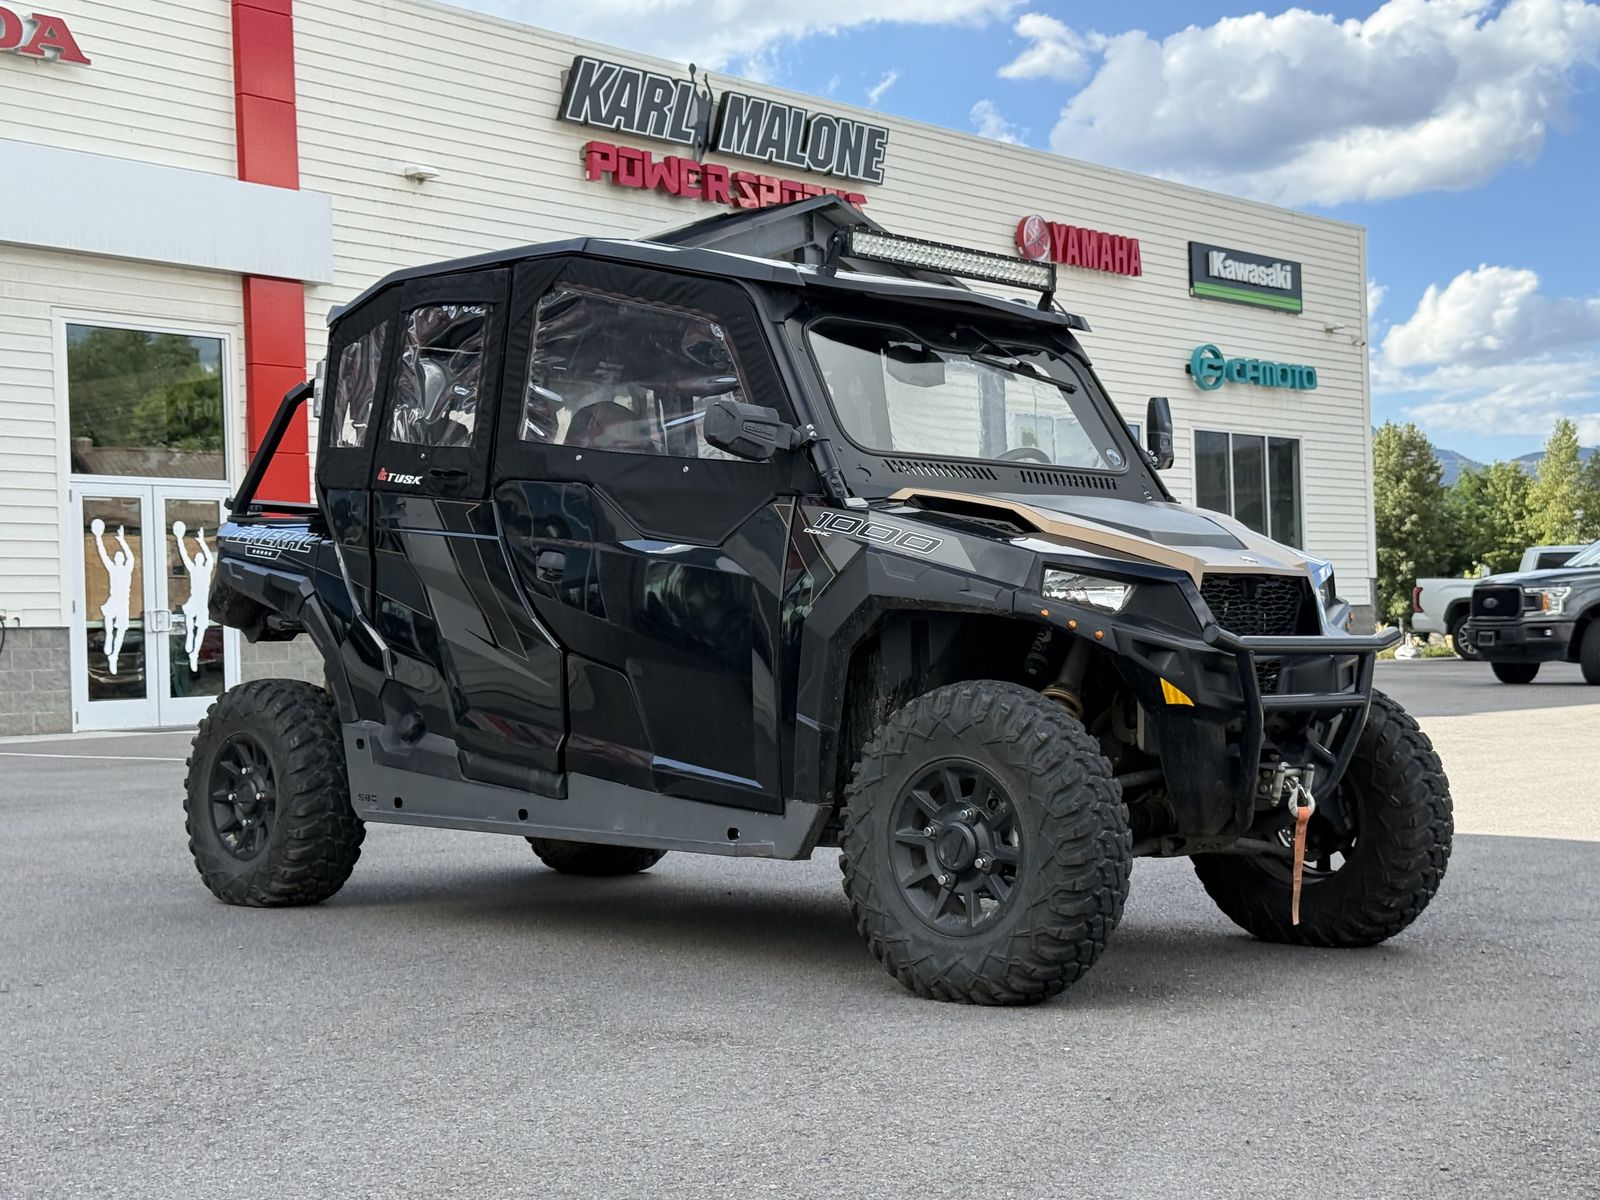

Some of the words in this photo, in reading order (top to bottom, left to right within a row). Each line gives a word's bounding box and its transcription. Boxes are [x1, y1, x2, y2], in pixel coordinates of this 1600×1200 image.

[562, 57, 697, 145] KARL
[714, 92, 889, 185] MALONE
[1047, 222, 1142, 276] YAMAHA
[1208, 250, 1292, 290] Kawasaki
[1227, 358, 1317, 390] CFMOTO
[387, 472, 423, 485] TUSK
[813, 511, 943, 554] 1000
